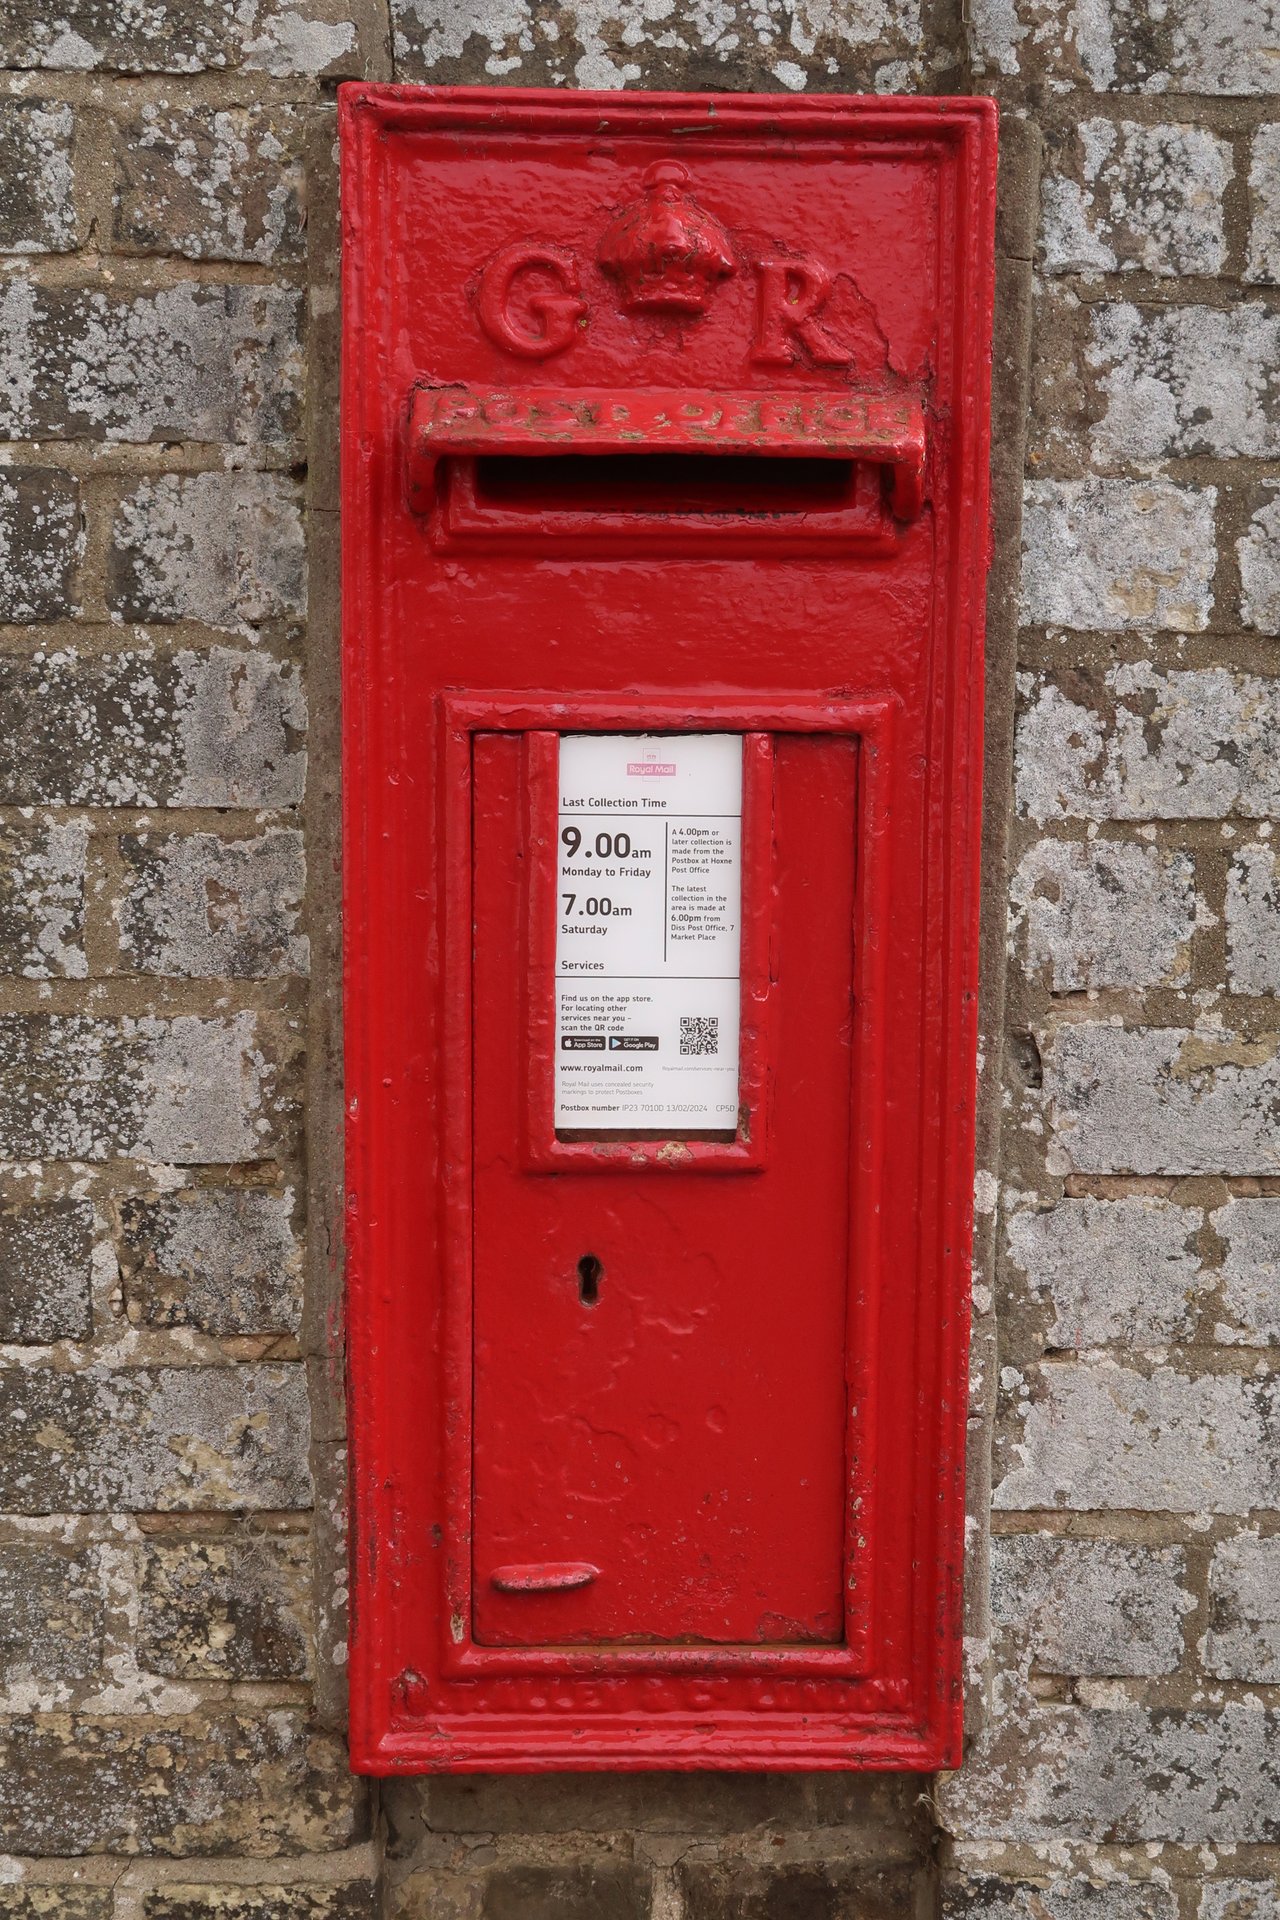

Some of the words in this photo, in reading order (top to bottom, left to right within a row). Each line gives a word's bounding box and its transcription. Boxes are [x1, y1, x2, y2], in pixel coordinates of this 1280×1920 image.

[476, 240, 589, 358] G
[753, 258, 854, 366] R
[629, 765, 653, 775] Royal
[655, 765, 674, 773] Mail
[562, 797, 585, 807] Last
[589, 797, 638, 807] Collection
[641, 798, 667, 808] Time
[678, 828, 710, 837] 4.00pm
[561, 826, 652, 859] 9.00am
[672, 838, 689, 846] later
[690, 838, 724, 846] collection
[726, 838, 732, 846] is
[562, 867, 602, 878] Monday
[605, 868, 616, 876] to
[619, 867, 651, 879] Friday
[671, 866, 688, 874] Post
[562, 893, 633, 916] 7.00am
[671, 914, 702, 923] 6.00pm
[561, 924, 608, 936] Saturday
[671, 924, 686, 932] Diss
[687, 924, 703, 932] Post
[705, 924, 728, 933] Office,
[671, 933, 696, 941] Market
[561, 960, 605, 970] Services
[561, 1004, 573, 1012] For
[575, 1004, 605, 1013] locating
[607, 1004, 627, 1012] other
[561, 1014, 591, 1022] services
[611, 1015, 626, 1023] you
[594, 1024, 605, 1032] QR
[560, 1064, 643, 1073] www.royalmail.com
[561, 1104, 589, 1112] Postbox
[622, 1104, 638, 1112] IP23
[667, 1104, 707, 1112] 13/02/2024
